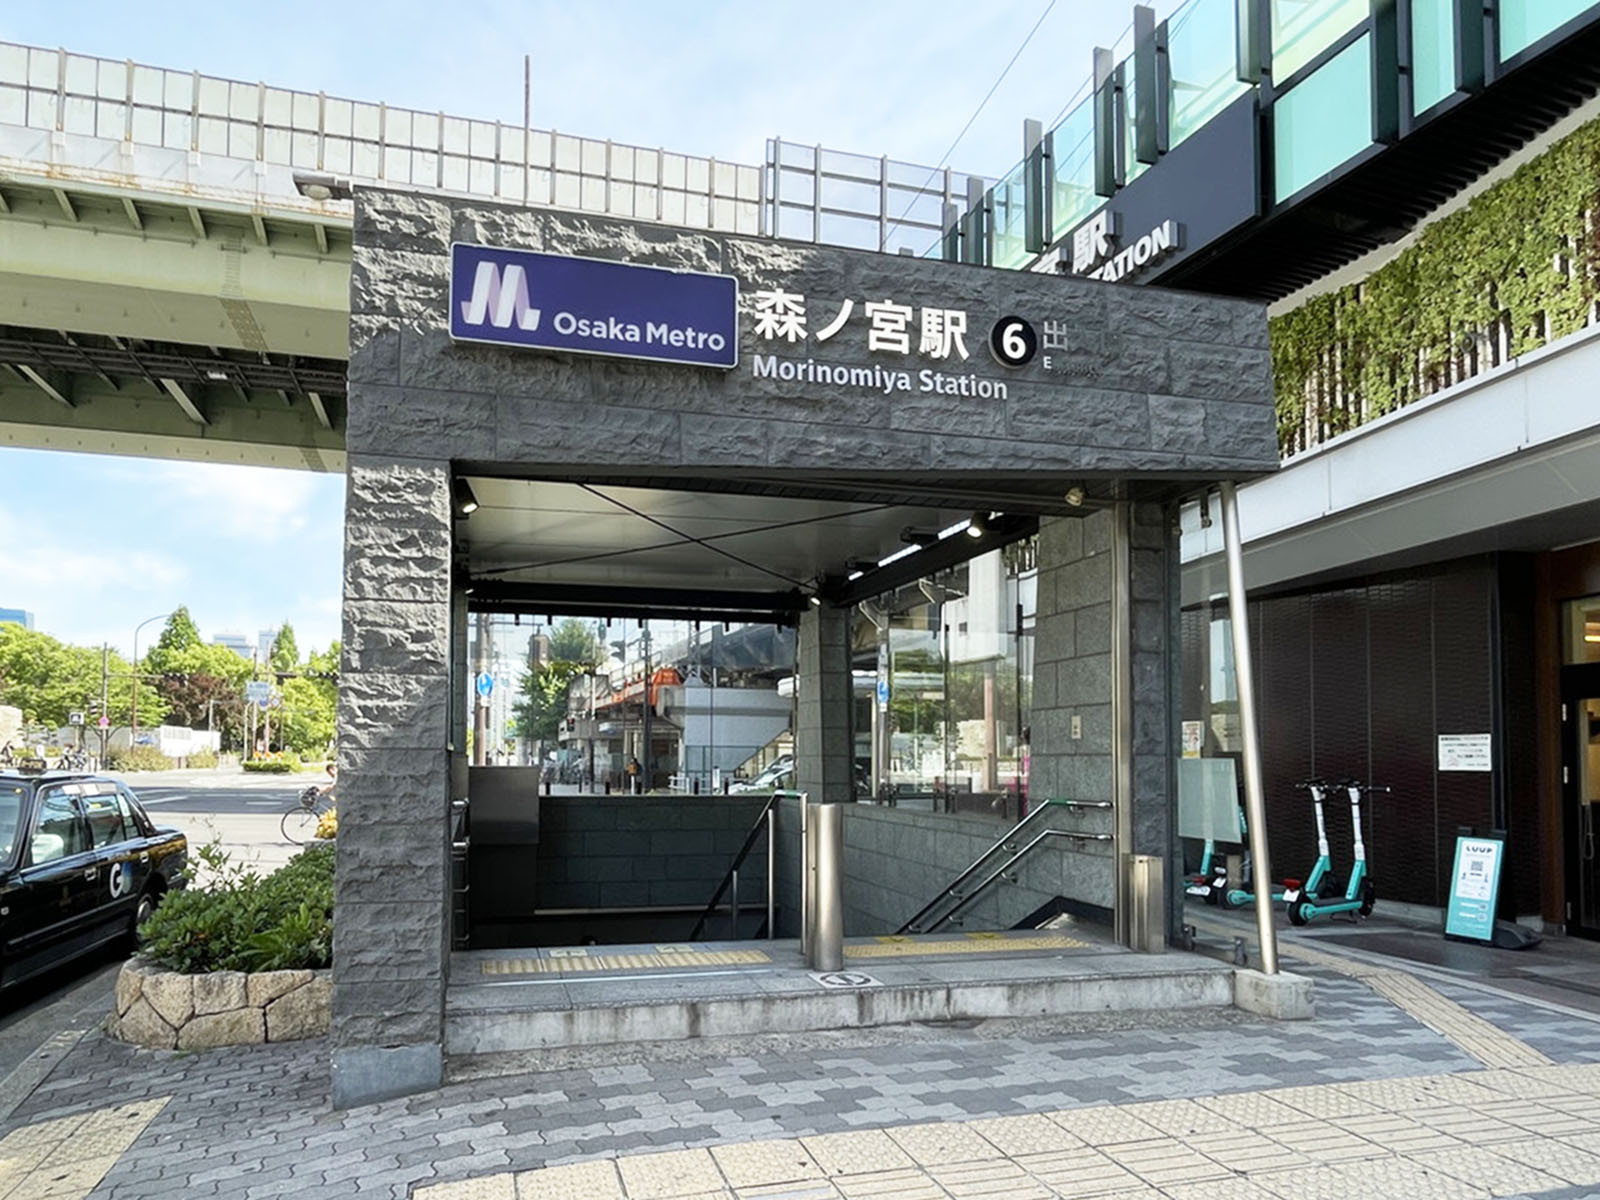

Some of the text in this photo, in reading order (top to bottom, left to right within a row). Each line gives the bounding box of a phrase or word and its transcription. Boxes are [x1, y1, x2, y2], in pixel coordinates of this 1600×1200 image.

[553, 312, 725, 351] Osaka Metro
[754, 287, 970, 361] 森ノ宮駅
[1002, 322, 1027, 360] 6
[753, 354, 1008, 400] Morinomiya Station
